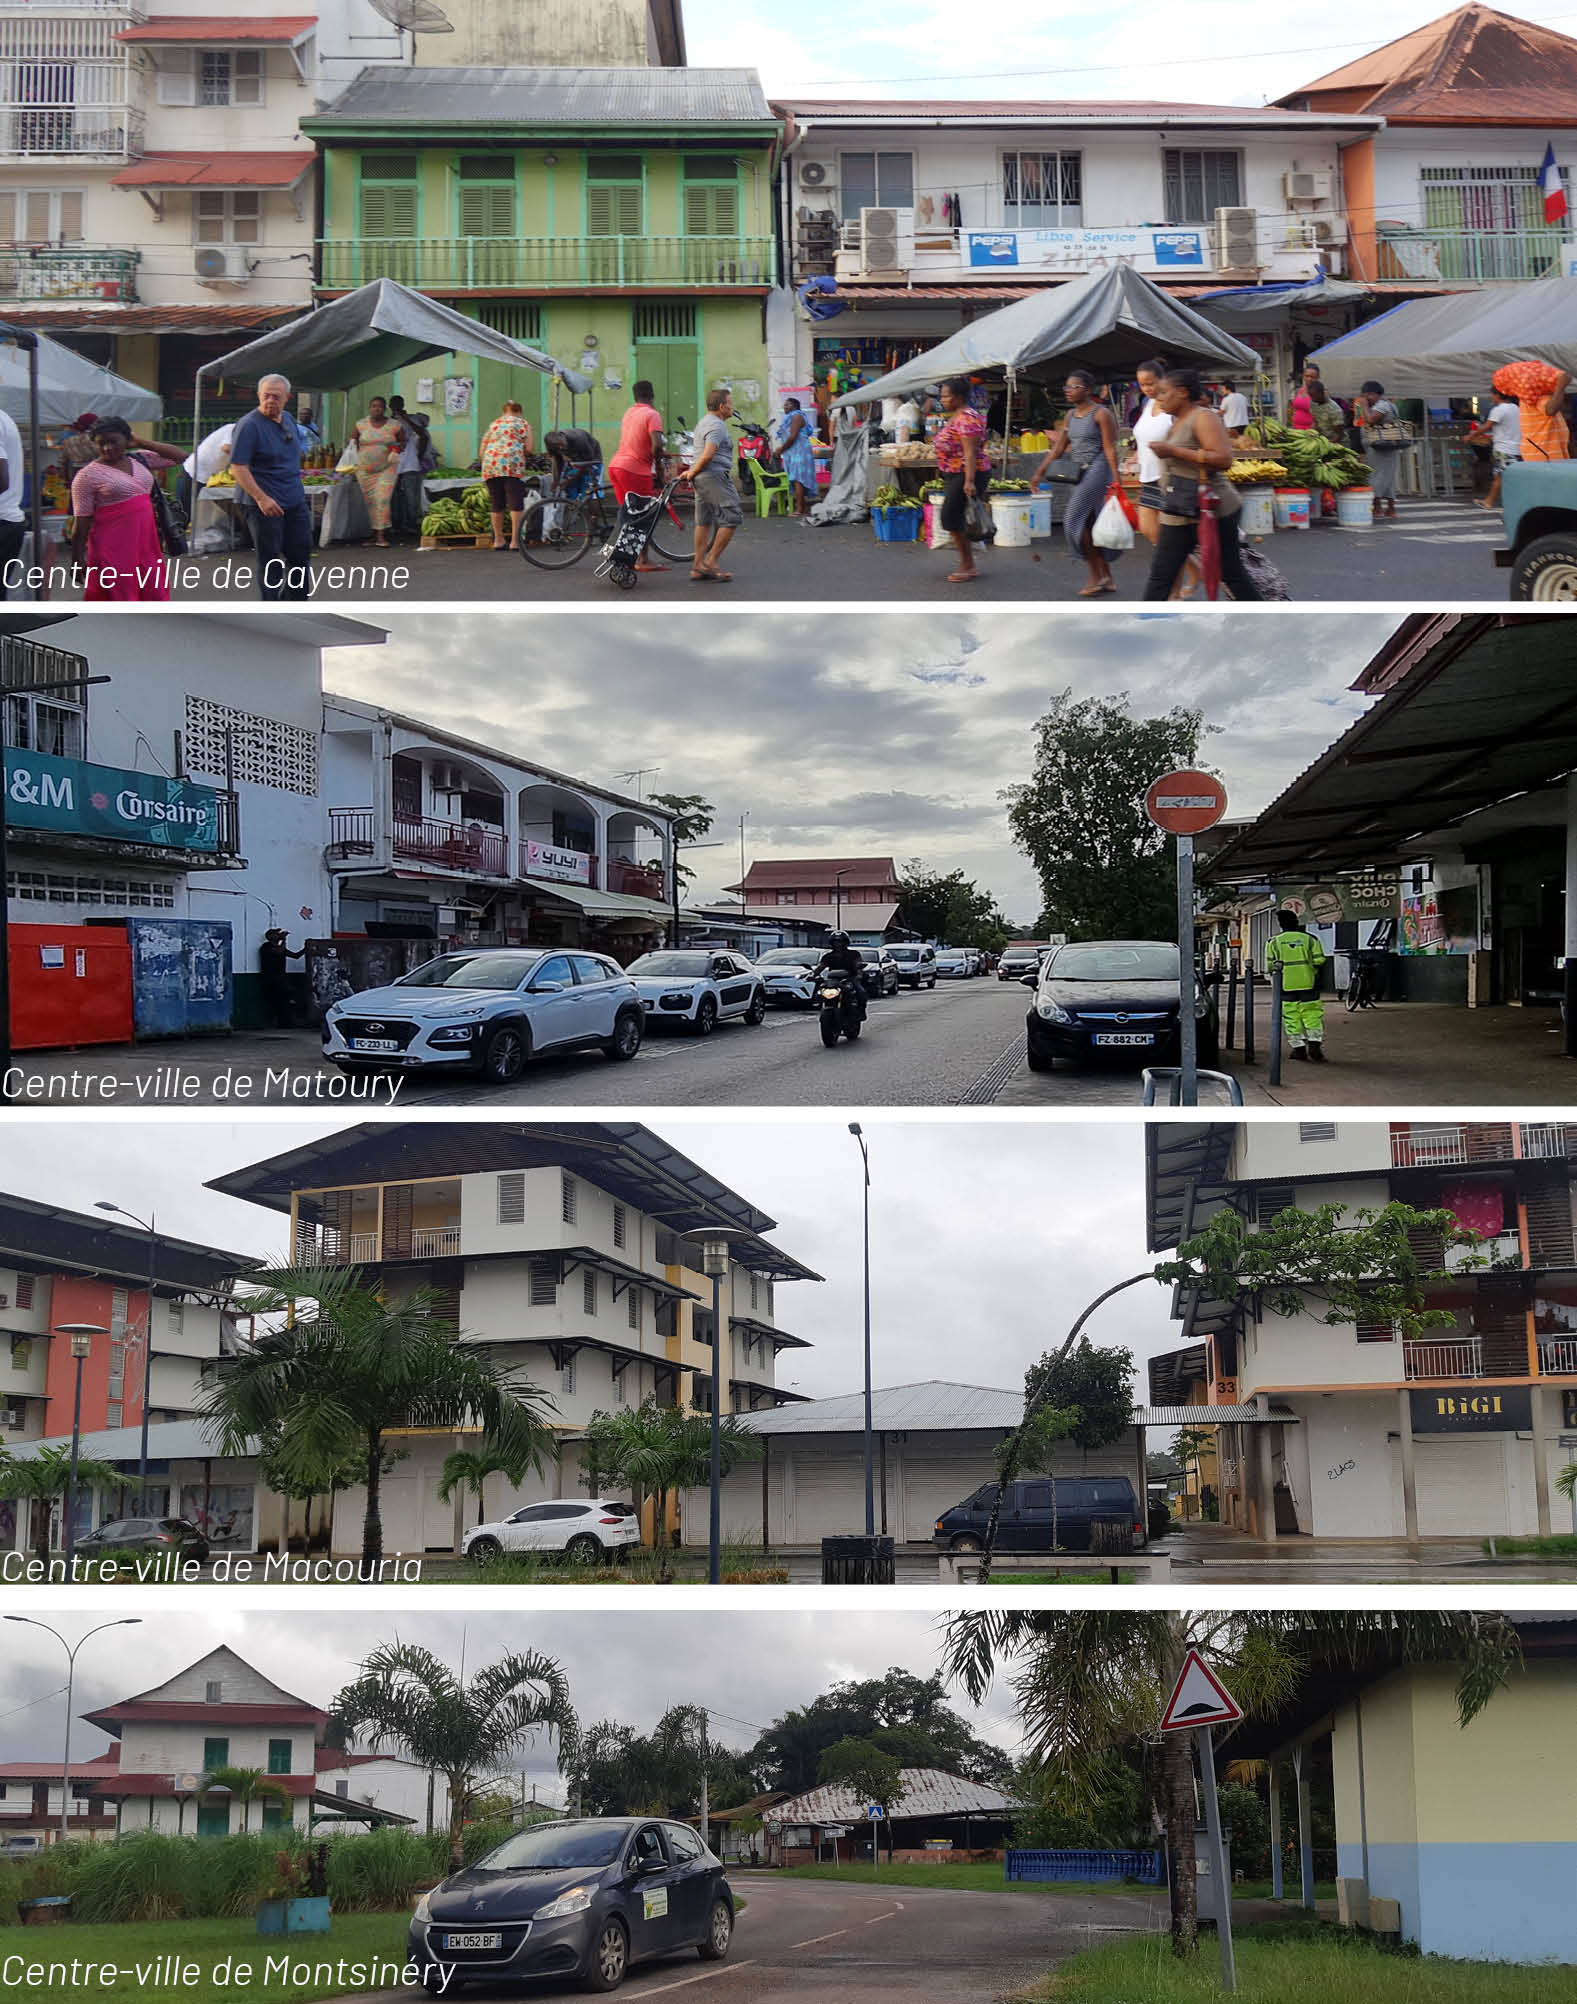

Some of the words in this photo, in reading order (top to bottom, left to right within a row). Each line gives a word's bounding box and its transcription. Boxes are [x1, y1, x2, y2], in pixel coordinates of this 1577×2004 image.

[972, 235, 1014, 246] PEPSI
[1035, 231, 1073, 242] Libre
[1083, 231, 1137, 243] Service
[1155, 235, 1197, 246] PEPSI
[116, 790, 208, 826] Corsaire
[1218, 1381, 1235, 1393] 33
